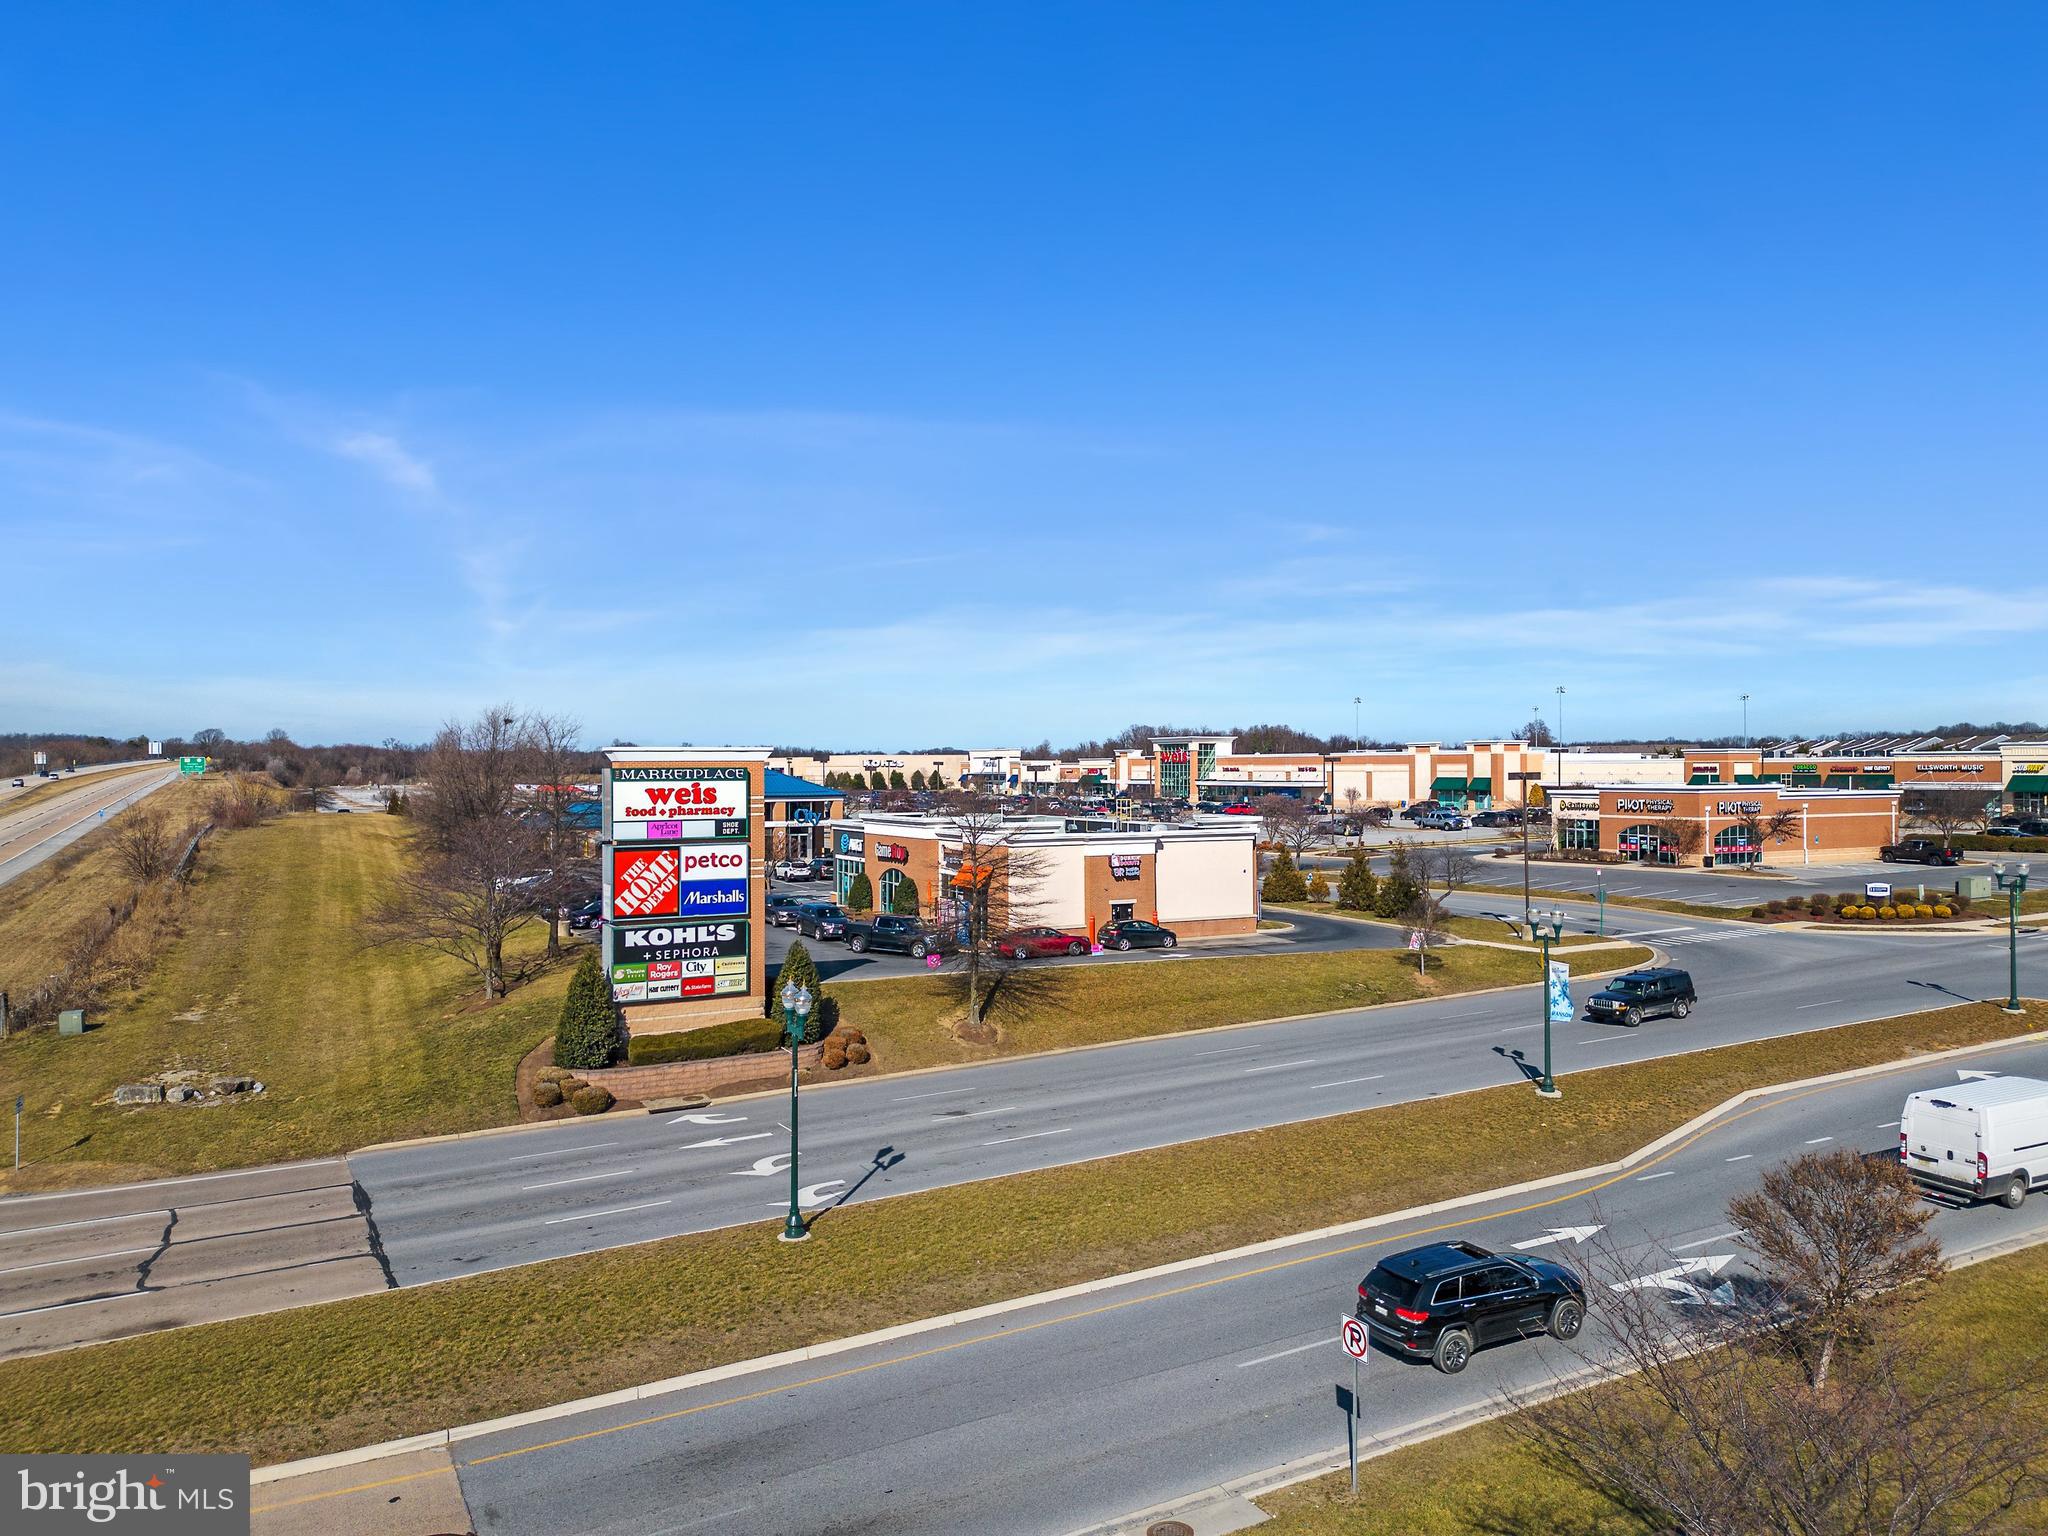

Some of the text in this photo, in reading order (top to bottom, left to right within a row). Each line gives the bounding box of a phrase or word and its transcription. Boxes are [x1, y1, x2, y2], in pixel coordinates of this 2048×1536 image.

[621, 768, 744, 780] MARKETPLACE
[644, 782, 717, 805] weis
[625, 806, 735, 818] food pharmacy
[1617, 799, 1645, 810] PIVOT
[1718, 801, 1741, 813] PIVOT
[794, 808, 821, 826] City
[651, 822, 678, 831] Apricot
[875, 842, 905, 861] GameStop
[620, 857, 648, 883] THE
[684, 852, 743, 873] petco
[614, 850, 679, 916] HOME
[640, 873, 679, 914] DEPOT
[683, 889, 745, 905] Marshalls
[625, 924, 736, 948] KOHL'S
[655, 946, 719, 961] SEPHORA
[656, 962, 673, 971] Roy
[685, 961, 707, 974] City
[650, 970, 679, 979] Rogers
